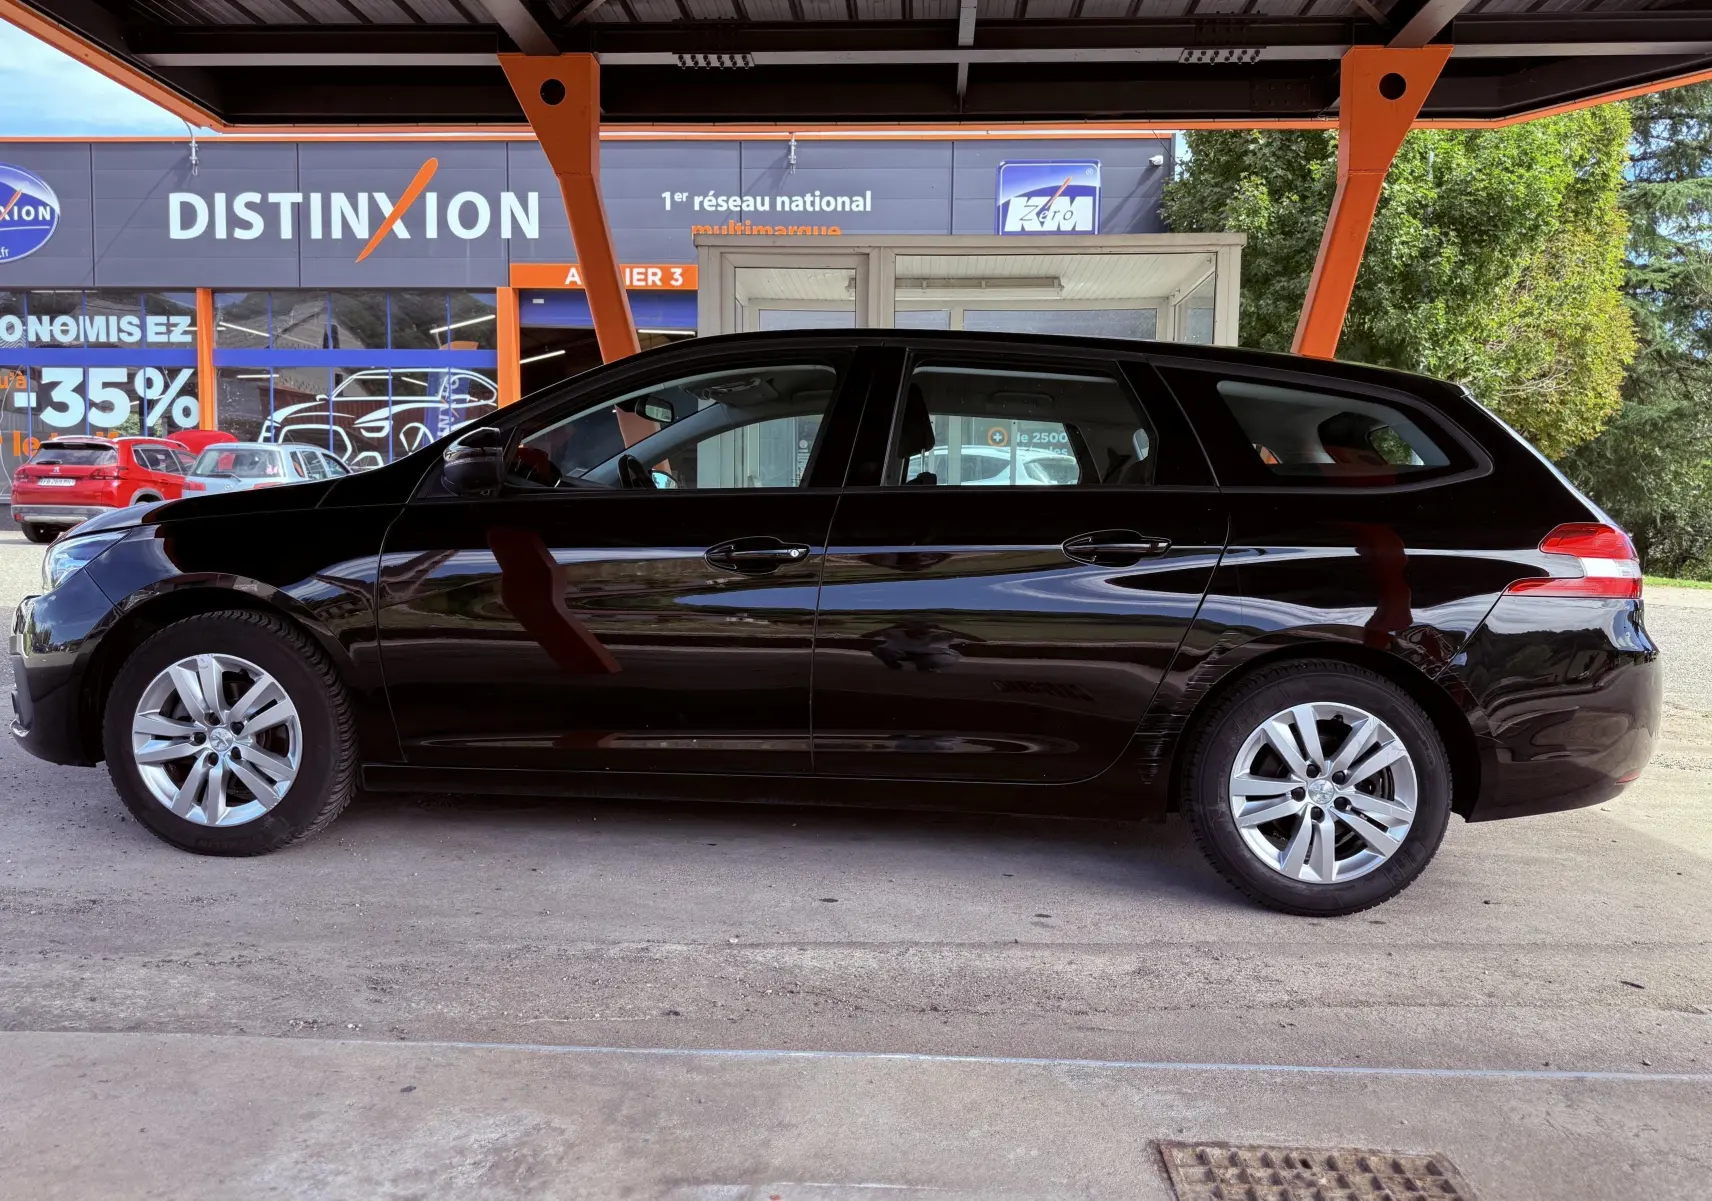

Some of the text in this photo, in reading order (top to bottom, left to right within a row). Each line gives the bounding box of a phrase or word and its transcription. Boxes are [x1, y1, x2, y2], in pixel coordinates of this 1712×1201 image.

[169, 157, 540, 263] DISTINXION
[662, 191, 872, 212] 1er réseau national
[1004, 196, 1093, 232] KM
[564, 267, 684, 287] AIER 3
[14, 366, 199, 428] -35%
[1032, 431, 1069, 444] 2500
